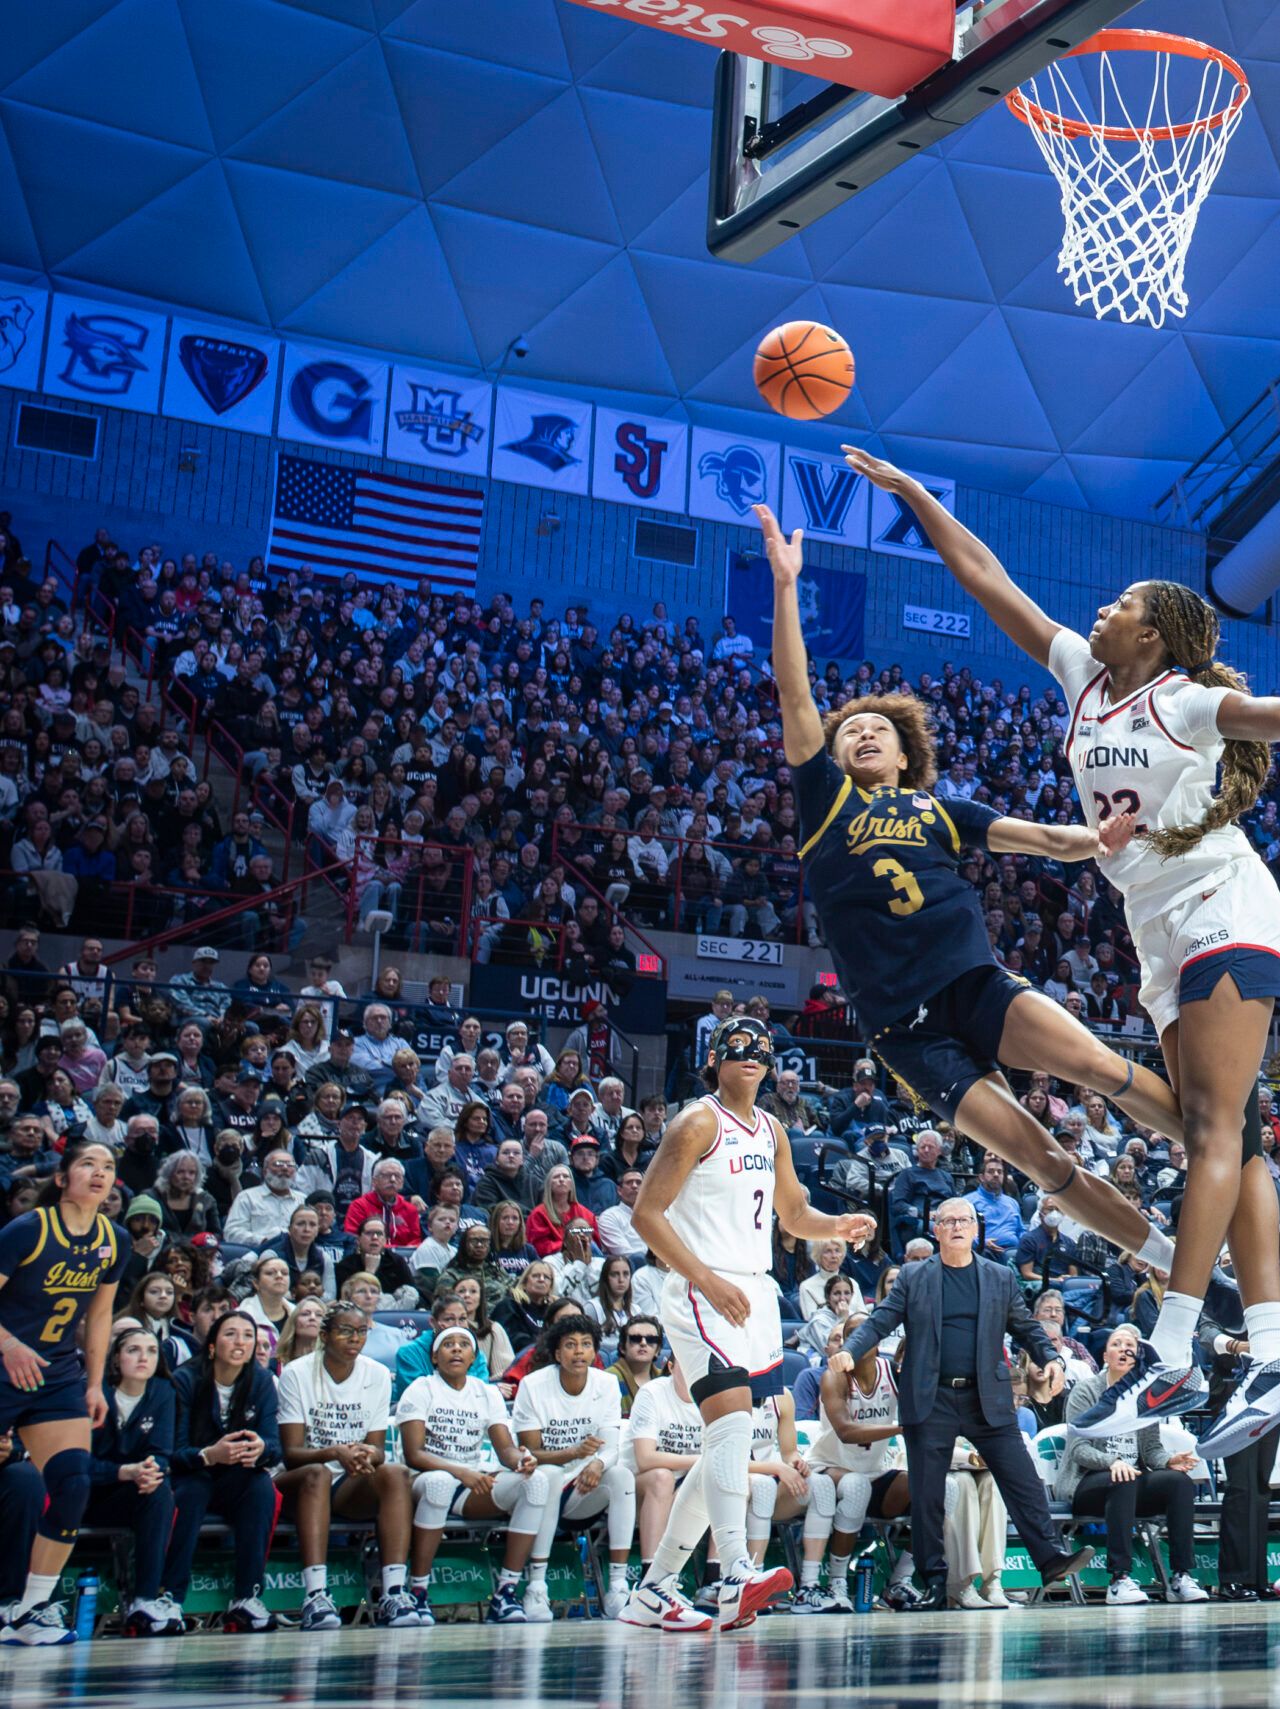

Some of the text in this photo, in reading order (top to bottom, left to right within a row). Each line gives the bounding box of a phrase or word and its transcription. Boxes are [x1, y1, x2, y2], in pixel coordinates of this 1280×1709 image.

[290, 361, 378, 444] G
[614, 422, 668, 498] SJ
[789, 456, 864, 536] V
[906, 611, 968, 633] SEC 222
[846, 812, 927, 855] Irish
[872, 858, 925, 915] 3
[701, 940, 783, 965] SEC 221
[417, 1034, 455, 1050] SEC
[753, 1189, 765, 1230] 2
[43, 1261, 100, 1293] Irish
[40, 1298, 78, 1342] 2
[336, 1402, 362, 1411] LIVES
[436, 1408, 479, 1419] OUR LIVES
[336, 1411, 348, 1420] TO
[428, 1415, 454, 1426] BEGIN
[455, 1418, 466, 1426] TO
[549, 1418, 569, 1427] OUR
[349, 1421, 364, 1429] WE
[431, 1424, 448, 1434] THE
[450, 1425, 465, 1435] DAY
[543, 1436, 561, 1445] THE
[561, 1436, 579, 1444] DAY
[658, 1430, 684, 1438] BEGIN
[660, 1438, 676, 1446] THE
[325, 1568, 357, 1585] ank
[441, 1566, 484, 1583] Bank
[549, 1567, 577, 1581] ank
